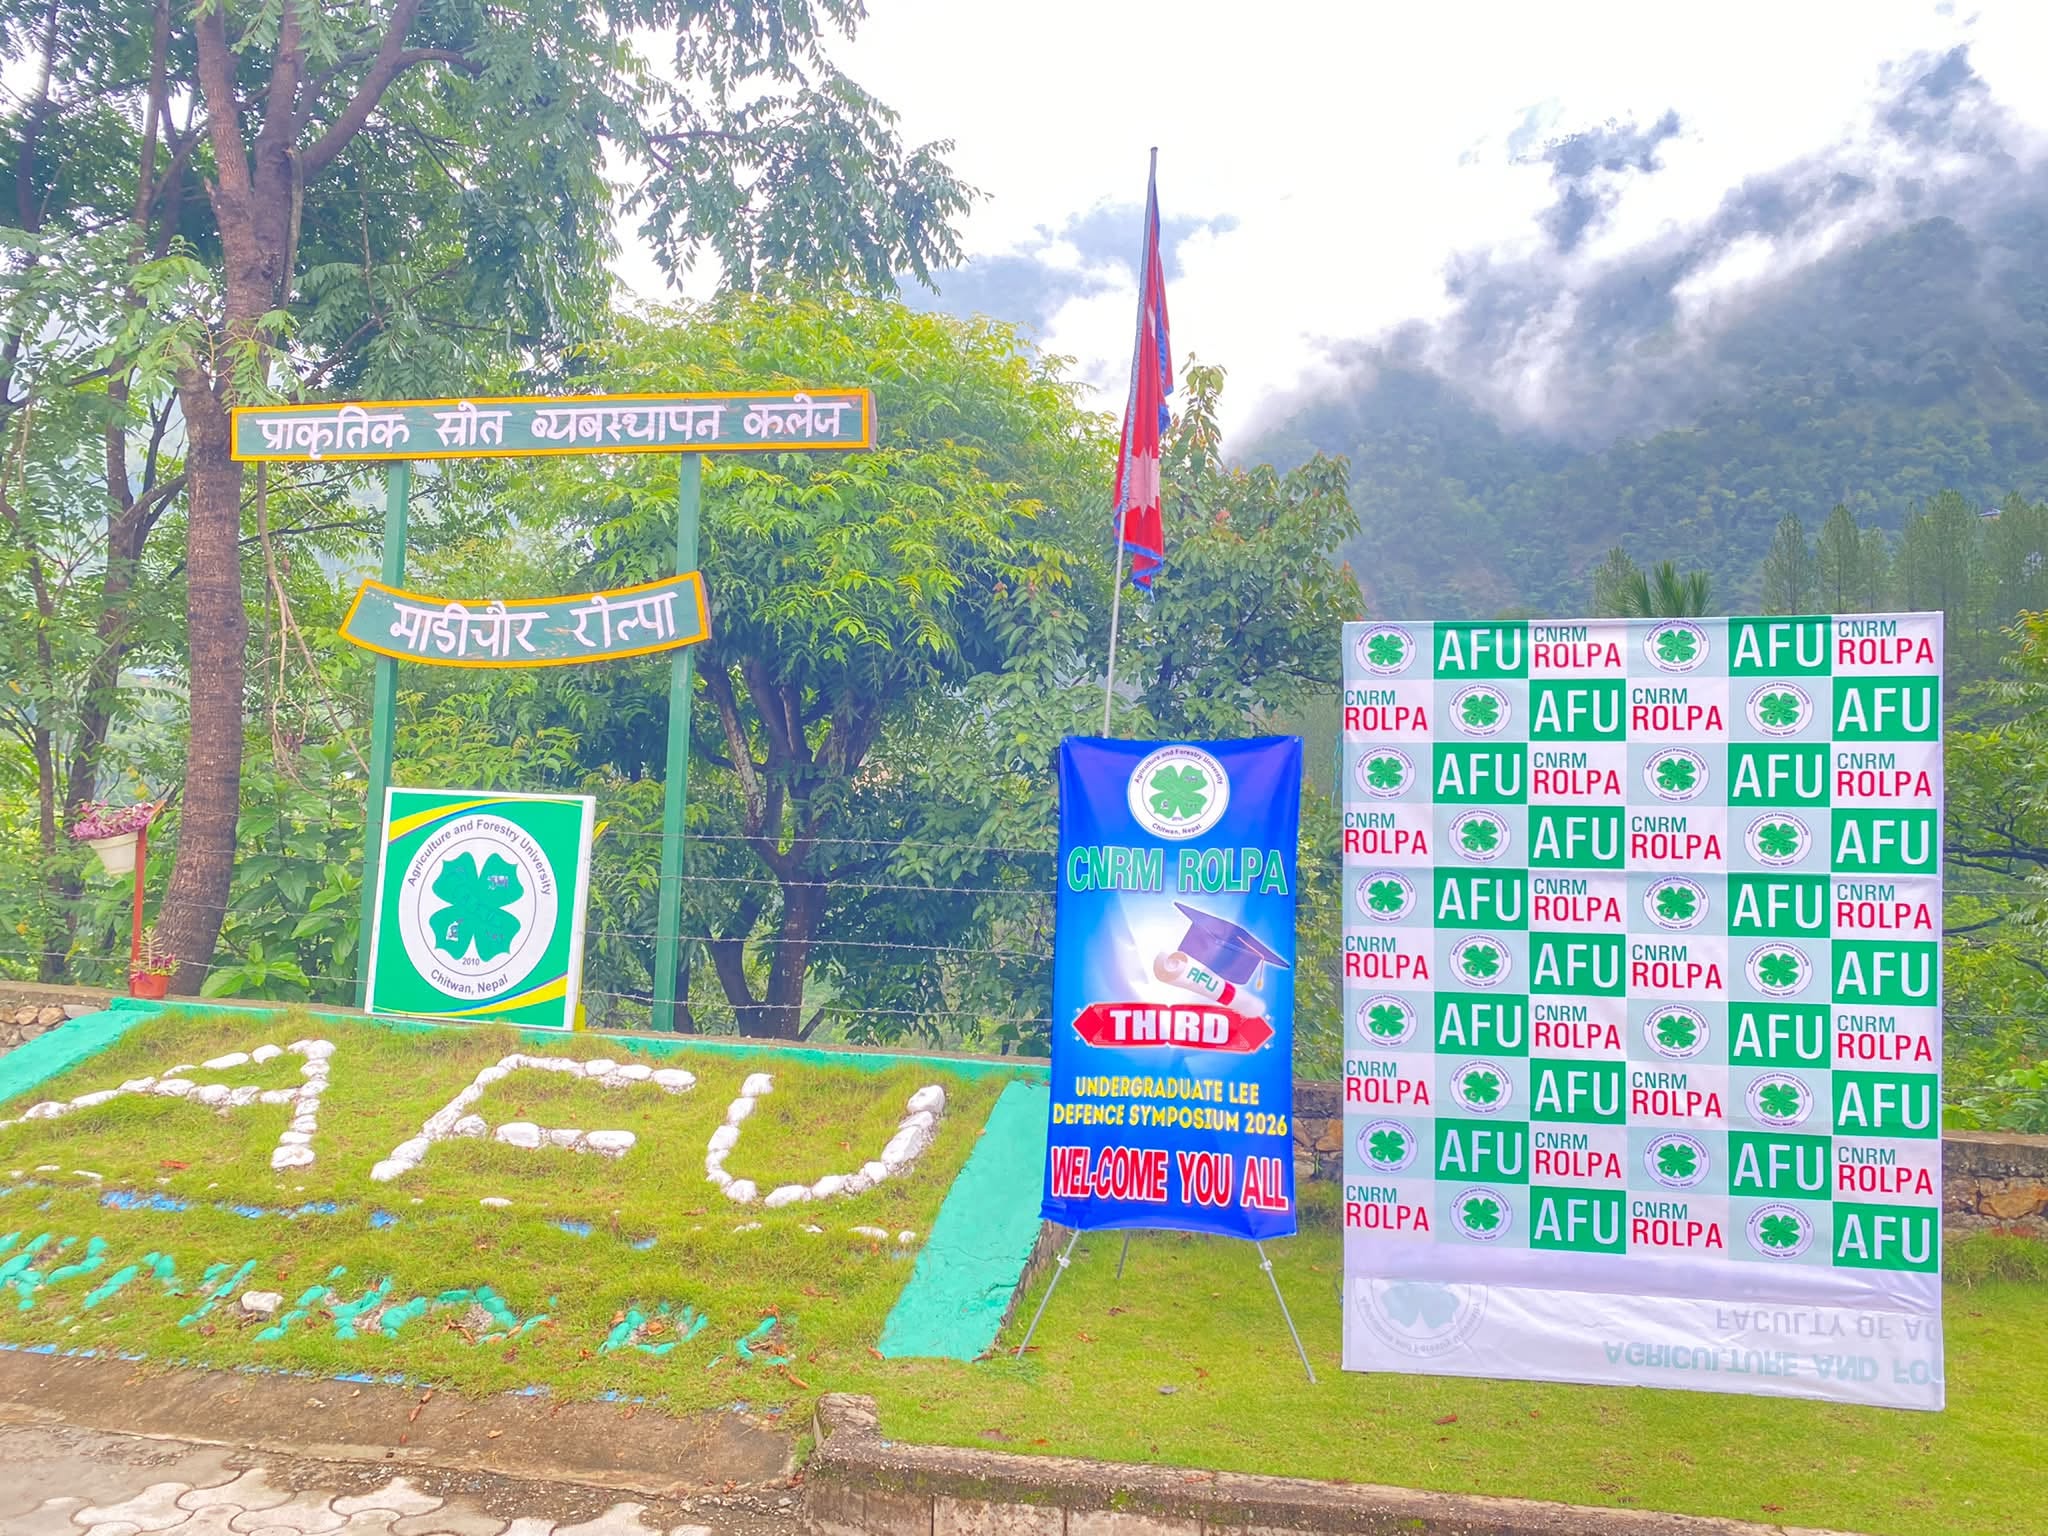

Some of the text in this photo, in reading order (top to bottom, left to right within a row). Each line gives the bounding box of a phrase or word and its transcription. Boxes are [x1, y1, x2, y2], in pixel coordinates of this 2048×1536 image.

[255, 405, 410, 459] प्राकृतिक
[743, 392, 852, 440] कलेज
[569, 591, 678, 649] रोल्पा
[1838, 620, 1896, 638] CNRM
[1534, 626, 1587, 642] CNRM
[1733, 623, 1824, 667] AFU
[1438, 628, 1521, 670] AFU
[1535, 643, 1621, 668] ROLPA
[1839, 638, 1933, 664] ROLPA
[1345, 691, 1395, 705] CNRM
[1633, 688, 1687, 704] CNRM
[1837, 687, 1930, 732] AFU
[1345, 707, 1427, 730] ROLPA
[1533, 689, 1618, 732] AFU
[1633, 706, 1722, 730] ROLPA
[1534, 753, 1586, 768] CNRM
[1838, 753, 1895, 769] CNRM
[1437, 753, 1520, 796] AFU
[1534, 770, 1620, 794] ROLPA
[1732, 753, 1822, 798] AFU
[1838, 771, 1930, 796] ROLPA
[1345, 813, 1394, 828] CNRM
[1632, 817, 1686, 832] CNRM
[1345, 830, 1427, 854] ROLPA
[1533, 816, 1617, 860] AFU
[1632, 834, 1720, 859] ROLPA
[1836, 819, 1929, 864] AFU
[407, 819, 551, 895] Agriculture and Forestry University
[1067, 846, 1288, 895] CNRM ROLPA
[1438, 877, 1520, 921] AFU
[1534, 880, 1587, 895] CNRM
[1838, 884, 1894, 901] CNRM
[1535, 896, 1620, 922] ROLPA
[1732, 883, 1822, 928] AFU
[1838, 902, 1931, 928] ROLPA
[1345, 936, 1396, 952] CNRM
[1633, 945, 1687, 961] CNRM
[1346, 953, 1428, 979] ROLPA
[1534, 943, 1618, 987] AFU
[1633, 962, 1722, 989] ROLPA
[1837, 951, 1929, 996] AFU
[430, 969, 508, 995] Chitwan, Nepal
[1187, 967, 1218, 992] AFU
[1110, 1010, 1230, 1044] THIRD
[1439, 1003, 1521, 1047] AFU
[1536, 1006, 1587, 1021] CNRM
[1838, 1016, 1895, 1032] CNRM
[1535, 1022, 1620, 1049] ROLPA
[1733, 1013, 1822, 1059] AFU
[1838, 1033, 1932, 1061] ROLPA
[1346, 1061, 1396, 1077] CNRM
[1633, 1072, 1687, 1089] CNRM
[1075, 1076, 1260, 1105] UNDERGRADUATE LEE
[1347, 1078, 1429, 1104] ROLPA
[1535, 1069, 1618, 1115] AFU
[1633, 1090, 1722, 1118] ROLPA
[1838, 1081, 1929, 1129] AFU
[1053, 1103, 1288, 1136] DEFENCE SYMPOSIUM 2026
[1439, 1129, 1521, 1174] AFU
[1535, 1132, 1588, 1149] CNRM
[1536, 1150, 1621, 1178] ROLPA
[1733, 1143, 1823, 1190] AFU
[1839, 1147, 1895, 1164] CNRM
[1177, 1151, 1232, 1207] YOU
[1240, 1156, 1288, 1210] ALL
[1839, 1164, 1933, 1195] ROLPA
[1347, 1186, 1397, 1203] CNRM
[1346, 1202, 1428, 1231] ROLPA
[1534, 1197, 1618, 1244] AFU
[1633, 1201, 1687, 1219] CNRM
[1633, 1219, 1722, 1248] ROLPA
[1837, 1214, 1929, 1263] AFU
